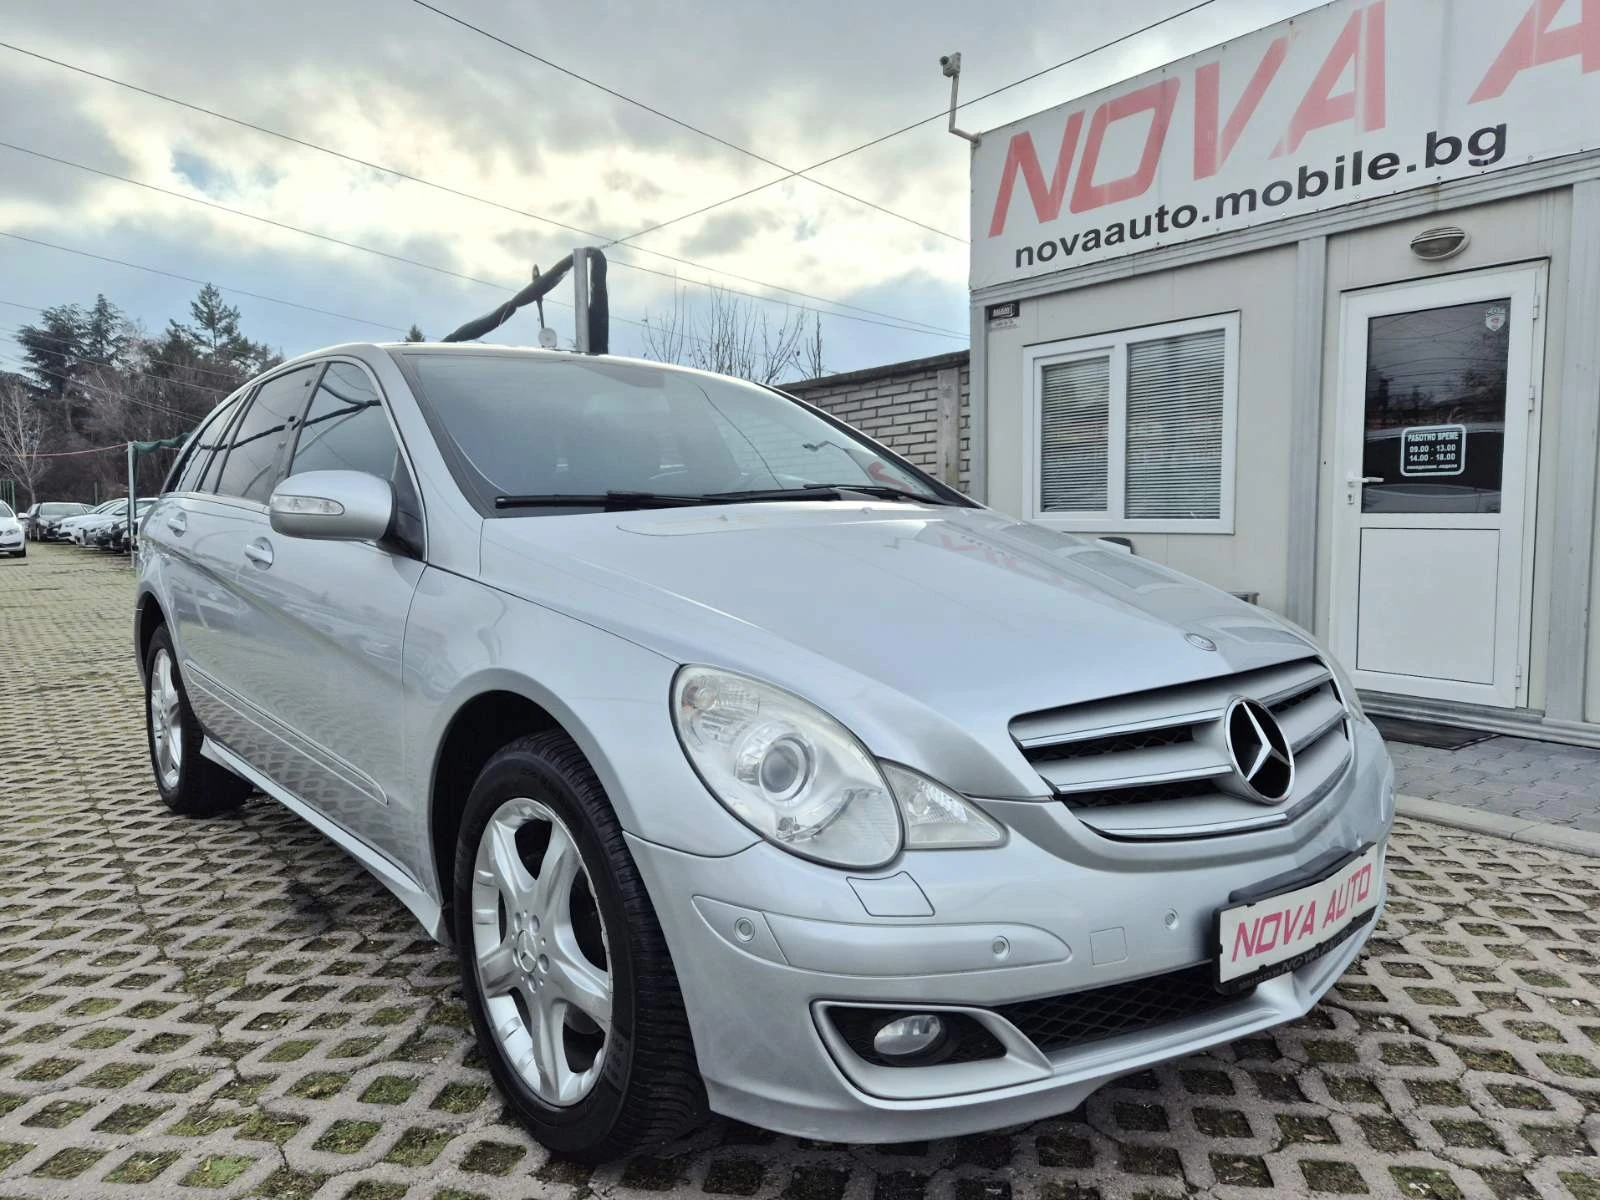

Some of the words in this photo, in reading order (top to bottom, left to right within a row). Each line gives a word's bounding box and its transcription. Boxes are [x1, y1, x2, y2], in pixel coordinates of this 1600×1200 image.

[989, 1, 1387, 237] NOVA
[1015, 122, 1508, 268] novaauto.mobile.bg
[1409, 444, 1430, 453] 09.00
[1436, 443, 1457, 452] 13.00
[1409, 453, 1429, 462] 14.00
[1232, 900, 1316, 962] NOVA
[1322, 863, 1372, 928] AUTO
